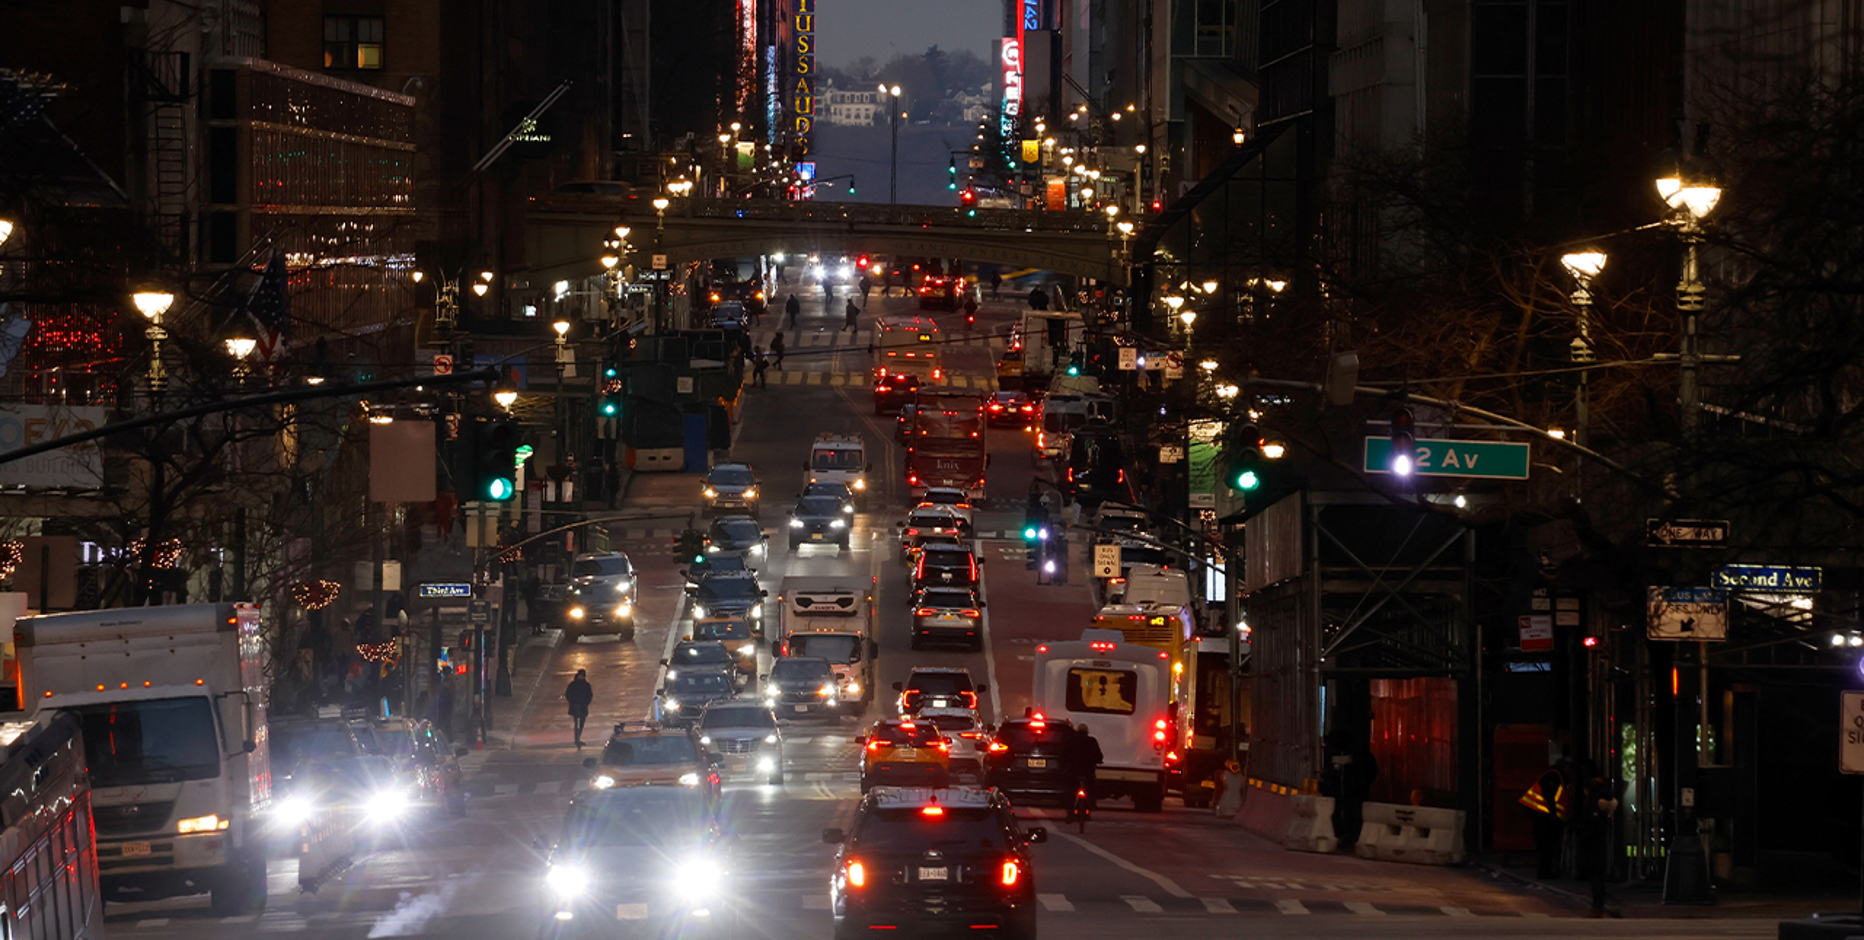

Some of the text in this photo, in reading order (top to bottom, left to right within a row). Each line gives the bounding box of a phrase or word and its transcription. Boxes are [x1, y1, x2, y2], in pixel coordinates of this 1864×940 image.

[1416, 447, 1479, 469] 2 Av
[1660, 528, 1719, 539] ONE WAY
[1783, 571, 1814, 588] Ave
[426, 586, 464, 594] Third Ave
